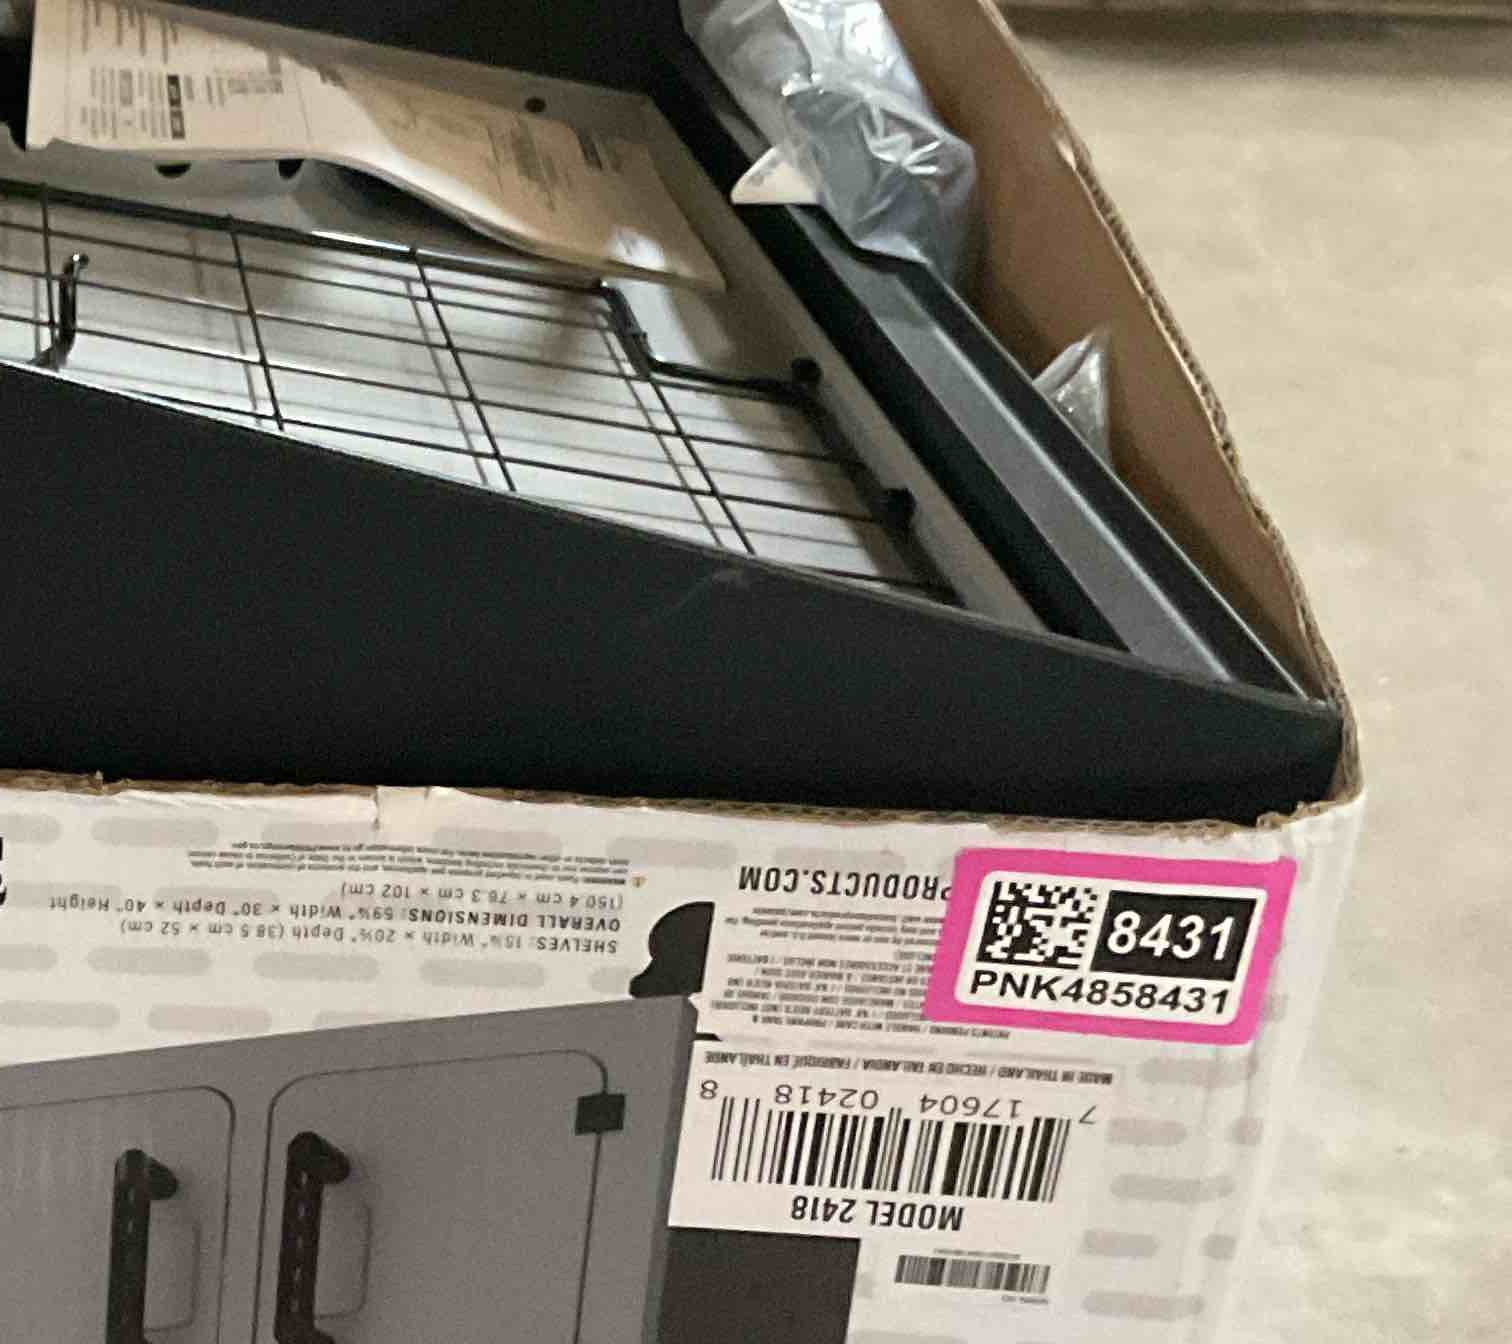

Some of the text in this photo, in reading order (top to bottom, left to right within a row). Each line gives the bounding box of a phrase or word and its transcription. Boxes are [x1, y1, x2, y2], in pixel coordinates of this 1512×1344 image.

[382, 883, 410, 899] 102
[438, 887, 464, 900] cm
[536, 892, 562, 904] cm
[49, 893, 110, 912] Height
[172, 897, 225, 916] Depth
[290, 903, 342, 919] Width
[162, 921, 180, 936] 52
[208, 922, 233, 934] cm
[292, 923, 344, 941] Depth
[536, 914, 620, 932] OVERALL
[1106, 910, 1235, 961] 8431
[971, 970, 1227, 1015] PNK4858431
[700, 1080, 1098, 1125] 7 17604 02418 8
[791, 1195, 965, 1231] MODEL 2418
